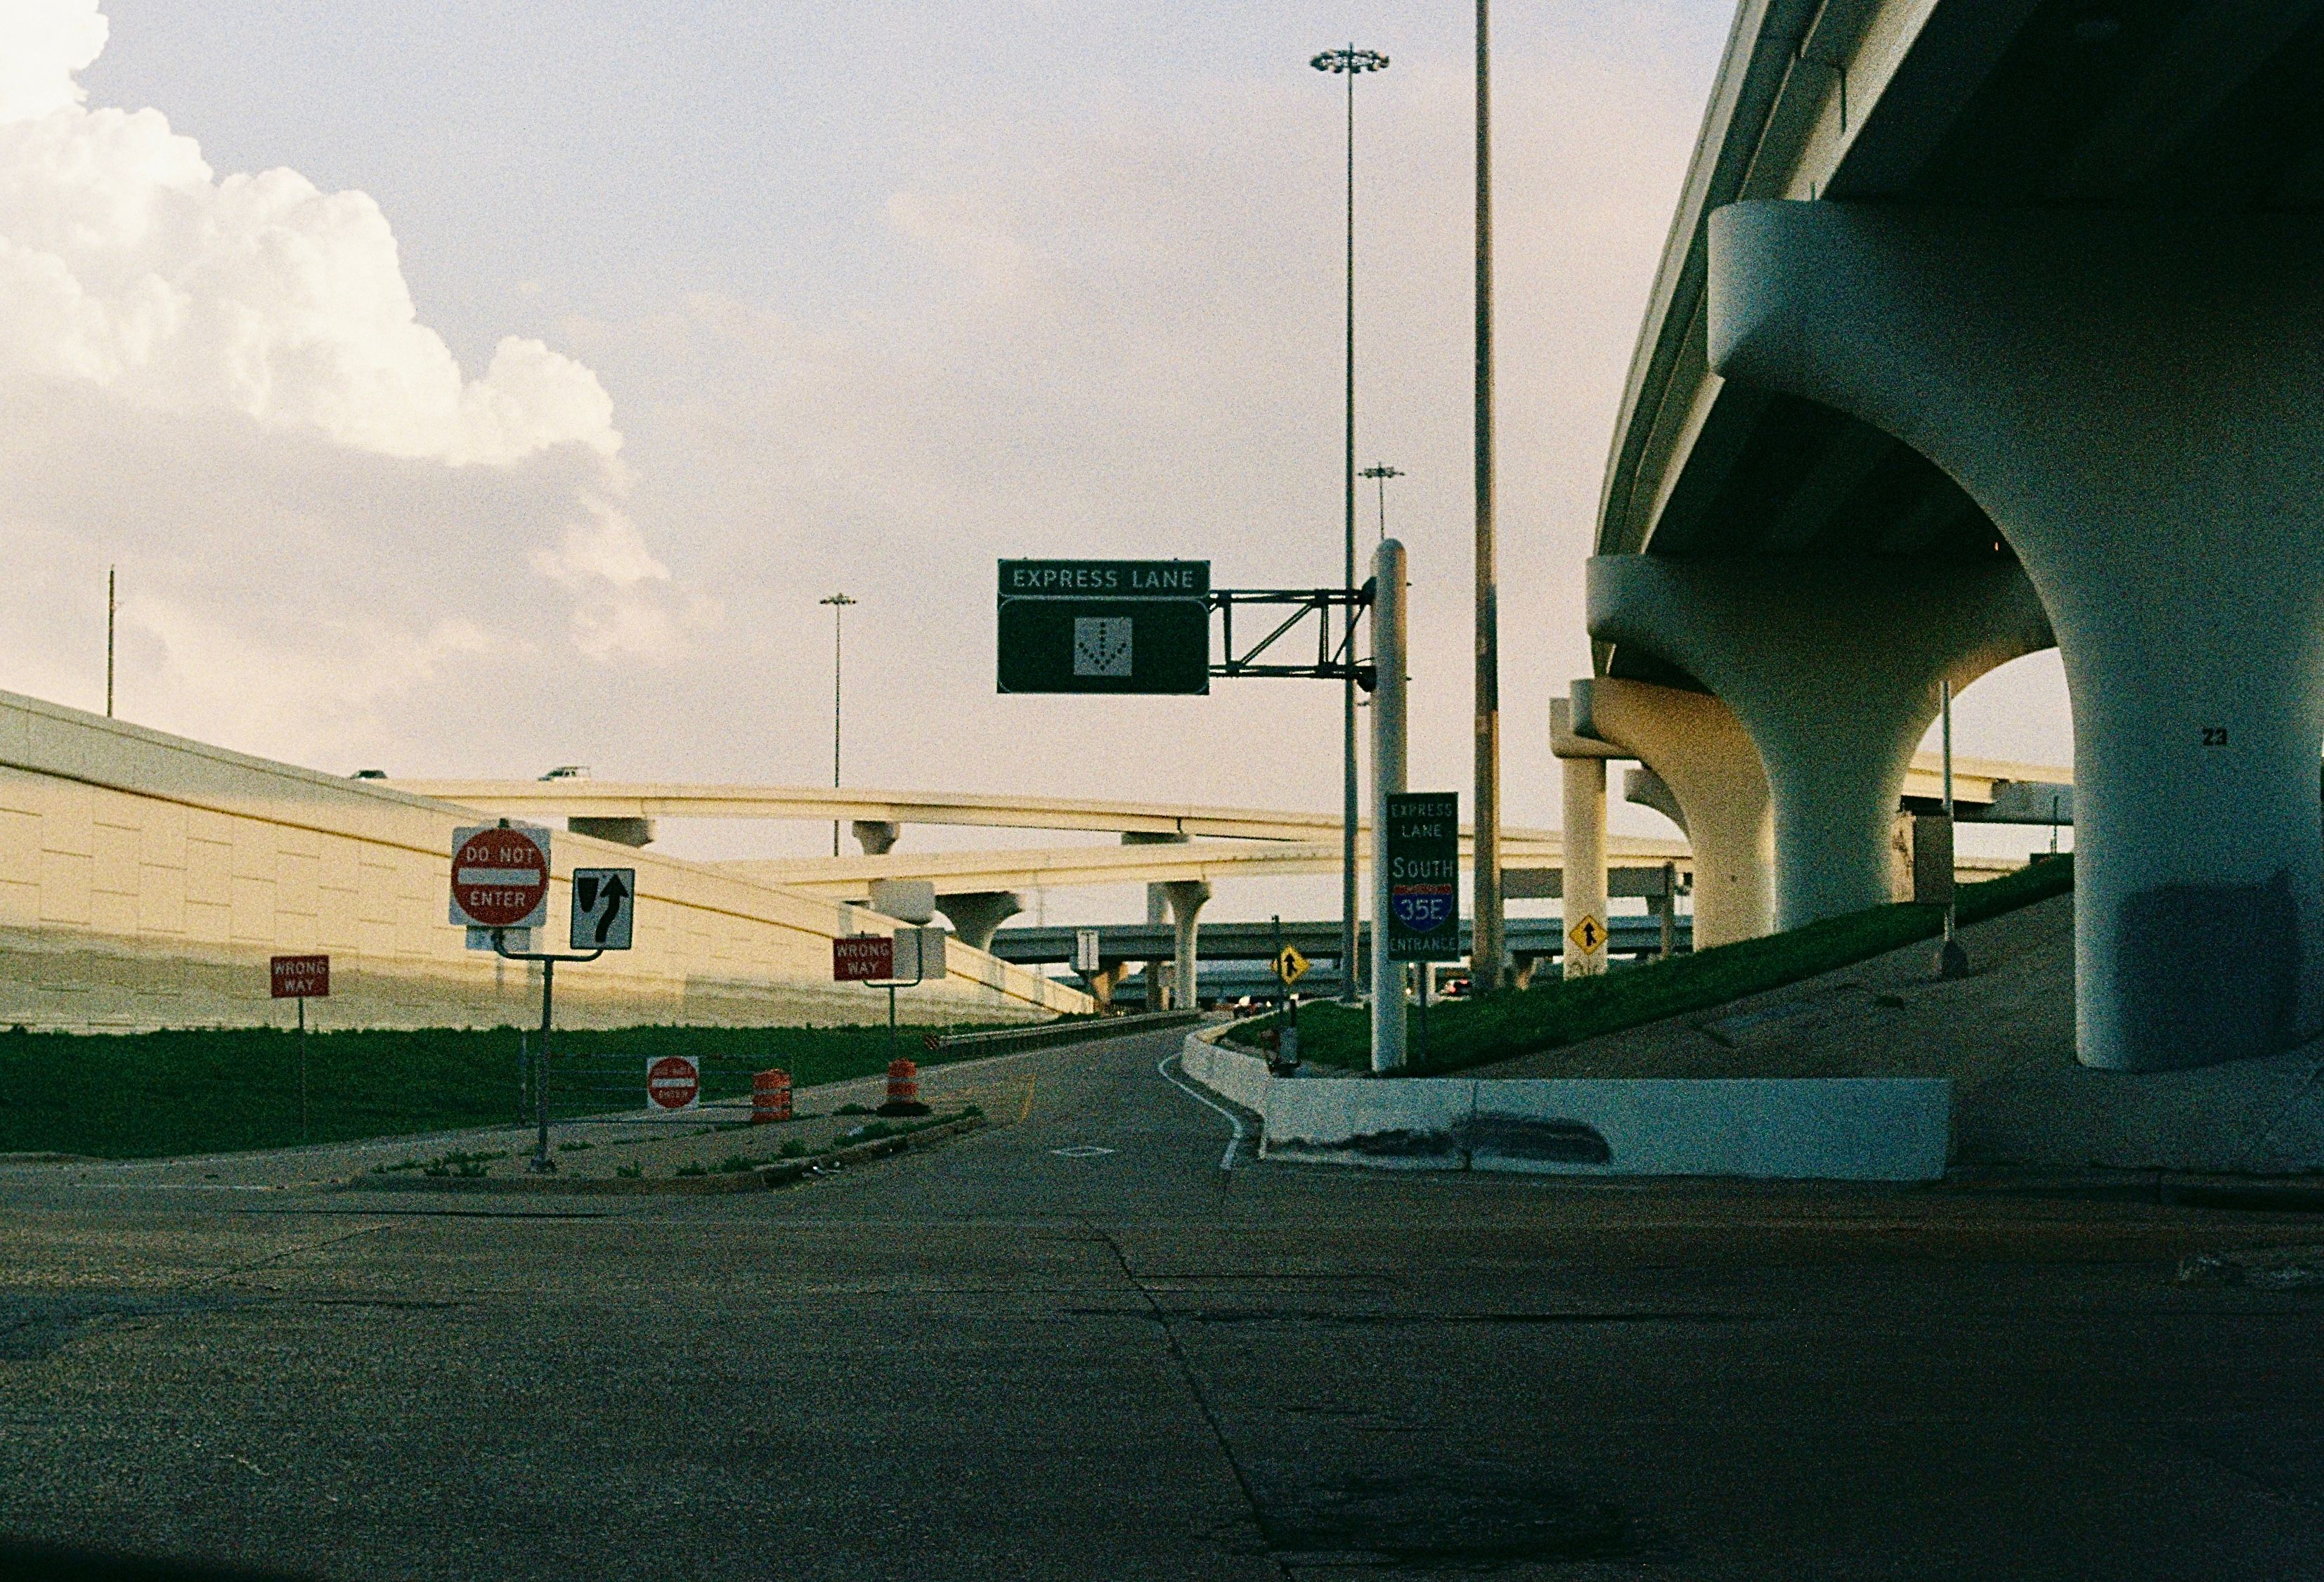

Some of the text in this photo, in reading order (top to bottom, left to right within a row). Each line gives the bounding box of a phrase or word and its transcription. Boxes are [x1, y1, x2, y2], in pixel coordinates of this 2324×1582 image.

[1013, 569, 1194, 588] EXPRESS LANE
[2202, 727, 2227, 746] 23
[1391, 803, 1453, 817] EXPRESS
[1402, 824, 1443, 837] LANE
[467, 846, 535, 863] DO NOT
[1392, 857, 1454, 878] SOUTH
[470, 890, 526, 907] ENTER
[1401, 898, 1443, 920] 35E
[836, 942, 889, 957] WRONG
[1389, 938, 1457, 951] ENTRANCE
[275, 961, 326, 975] WRONG
[848, 961, 879, 975] WAY
[285, 979, 316, 992] WAY
